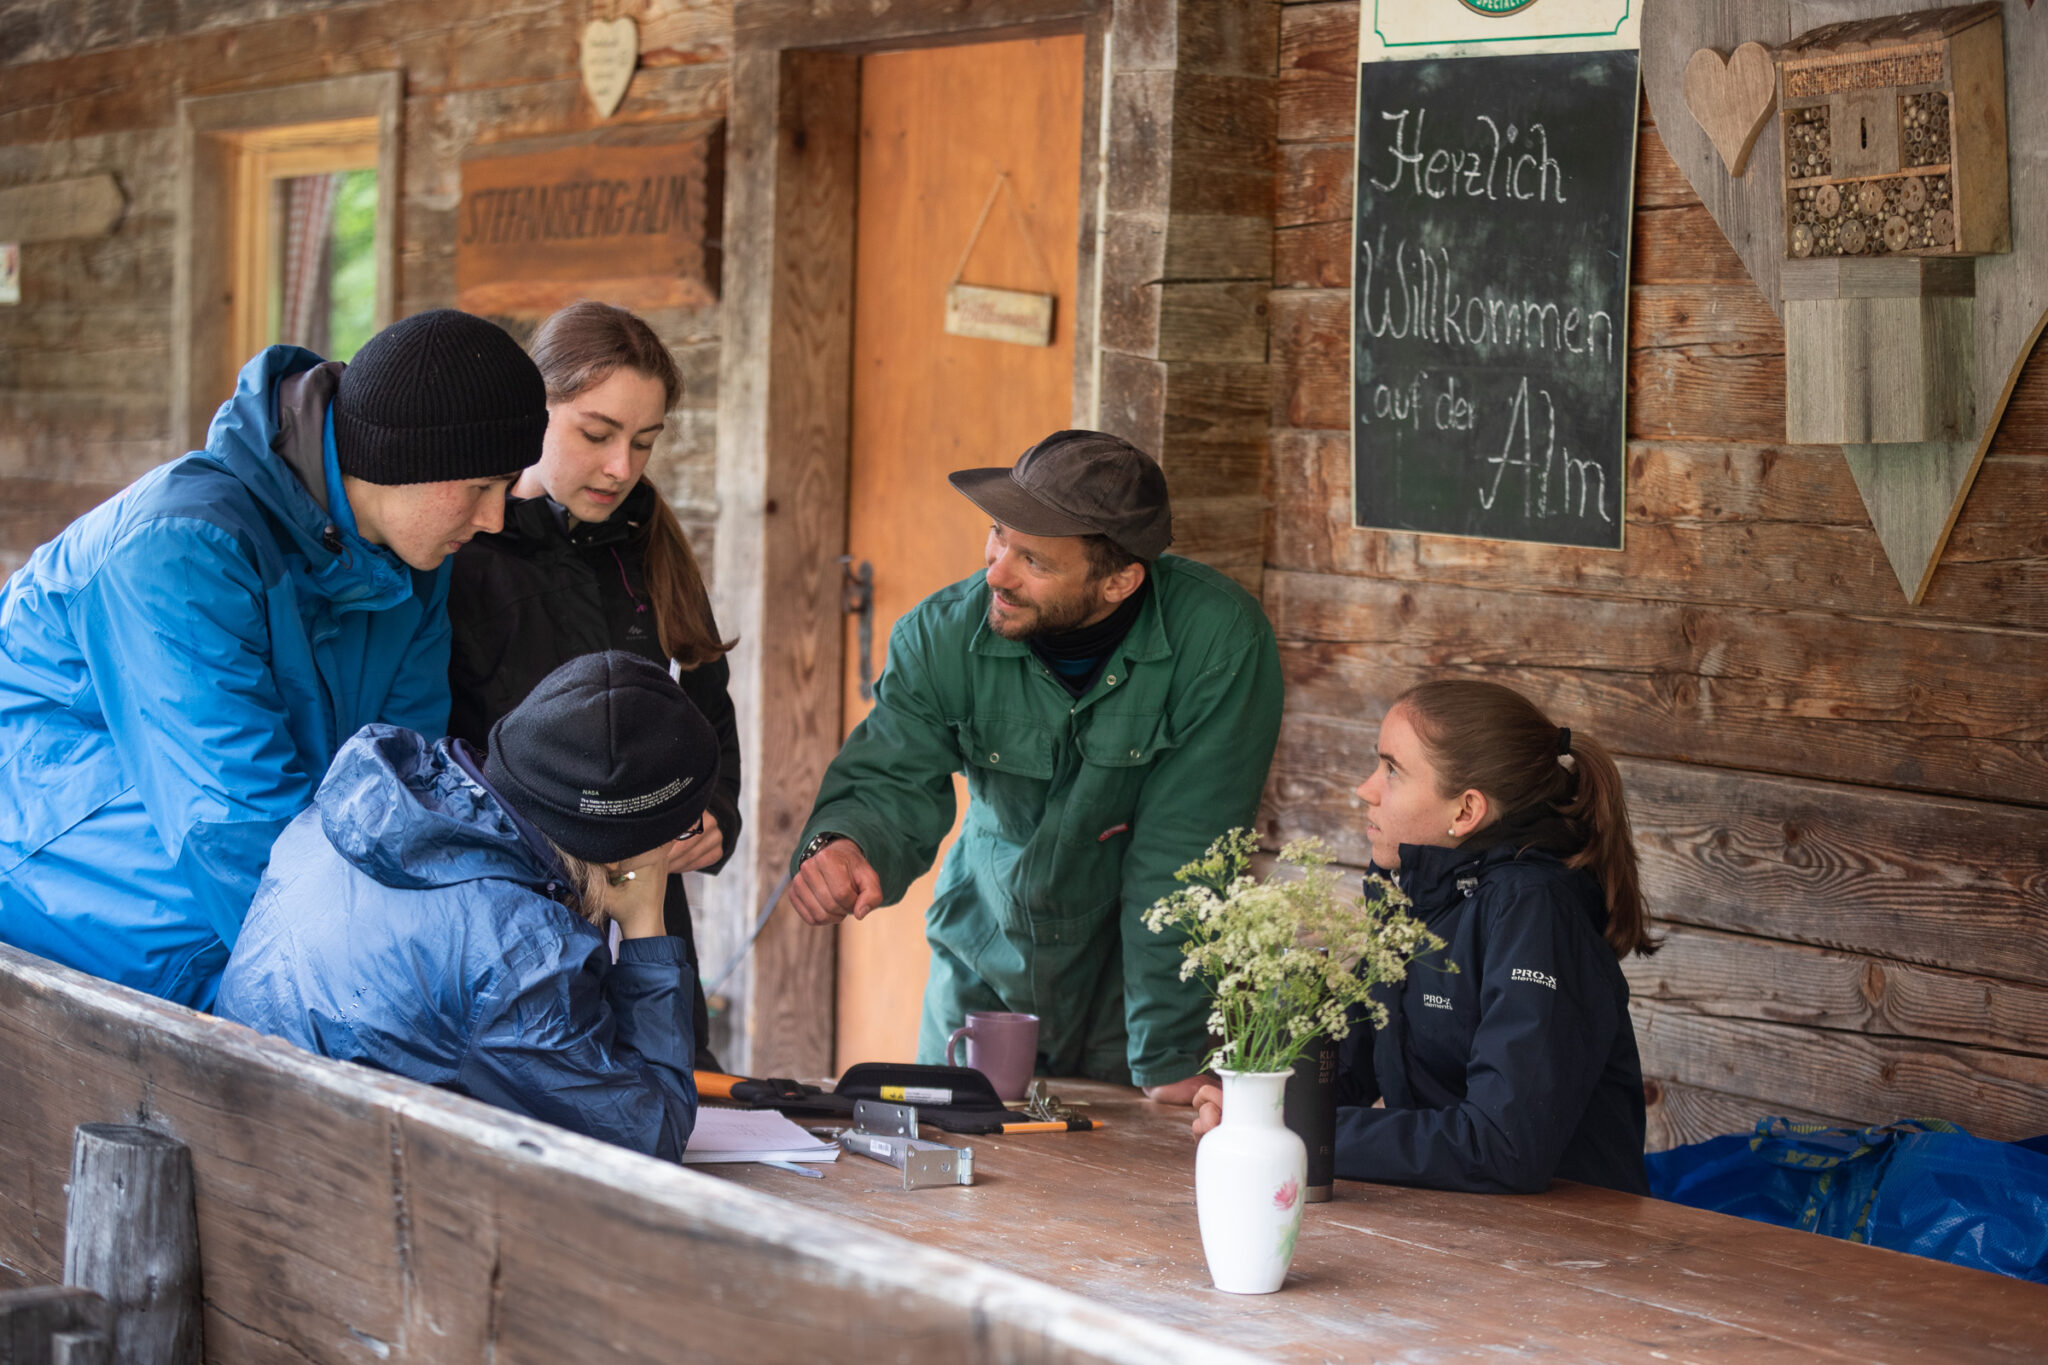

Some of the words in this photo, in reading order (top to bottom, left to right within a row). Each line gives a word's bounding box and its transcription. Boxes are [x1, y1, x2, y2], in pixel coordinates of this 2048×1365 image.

[1370, 108, 1567, 204] Herzlich
[1362, 239, 1613, 363] Willkommen
[1374, 370, 1428, 430] auf
[1434, 377, 1474, 430] der
[1479, 376, 1612, 524] Alm
[1511, 968, 1557, 986] PRO-X
[1511, 975, 1557, 990] elements
